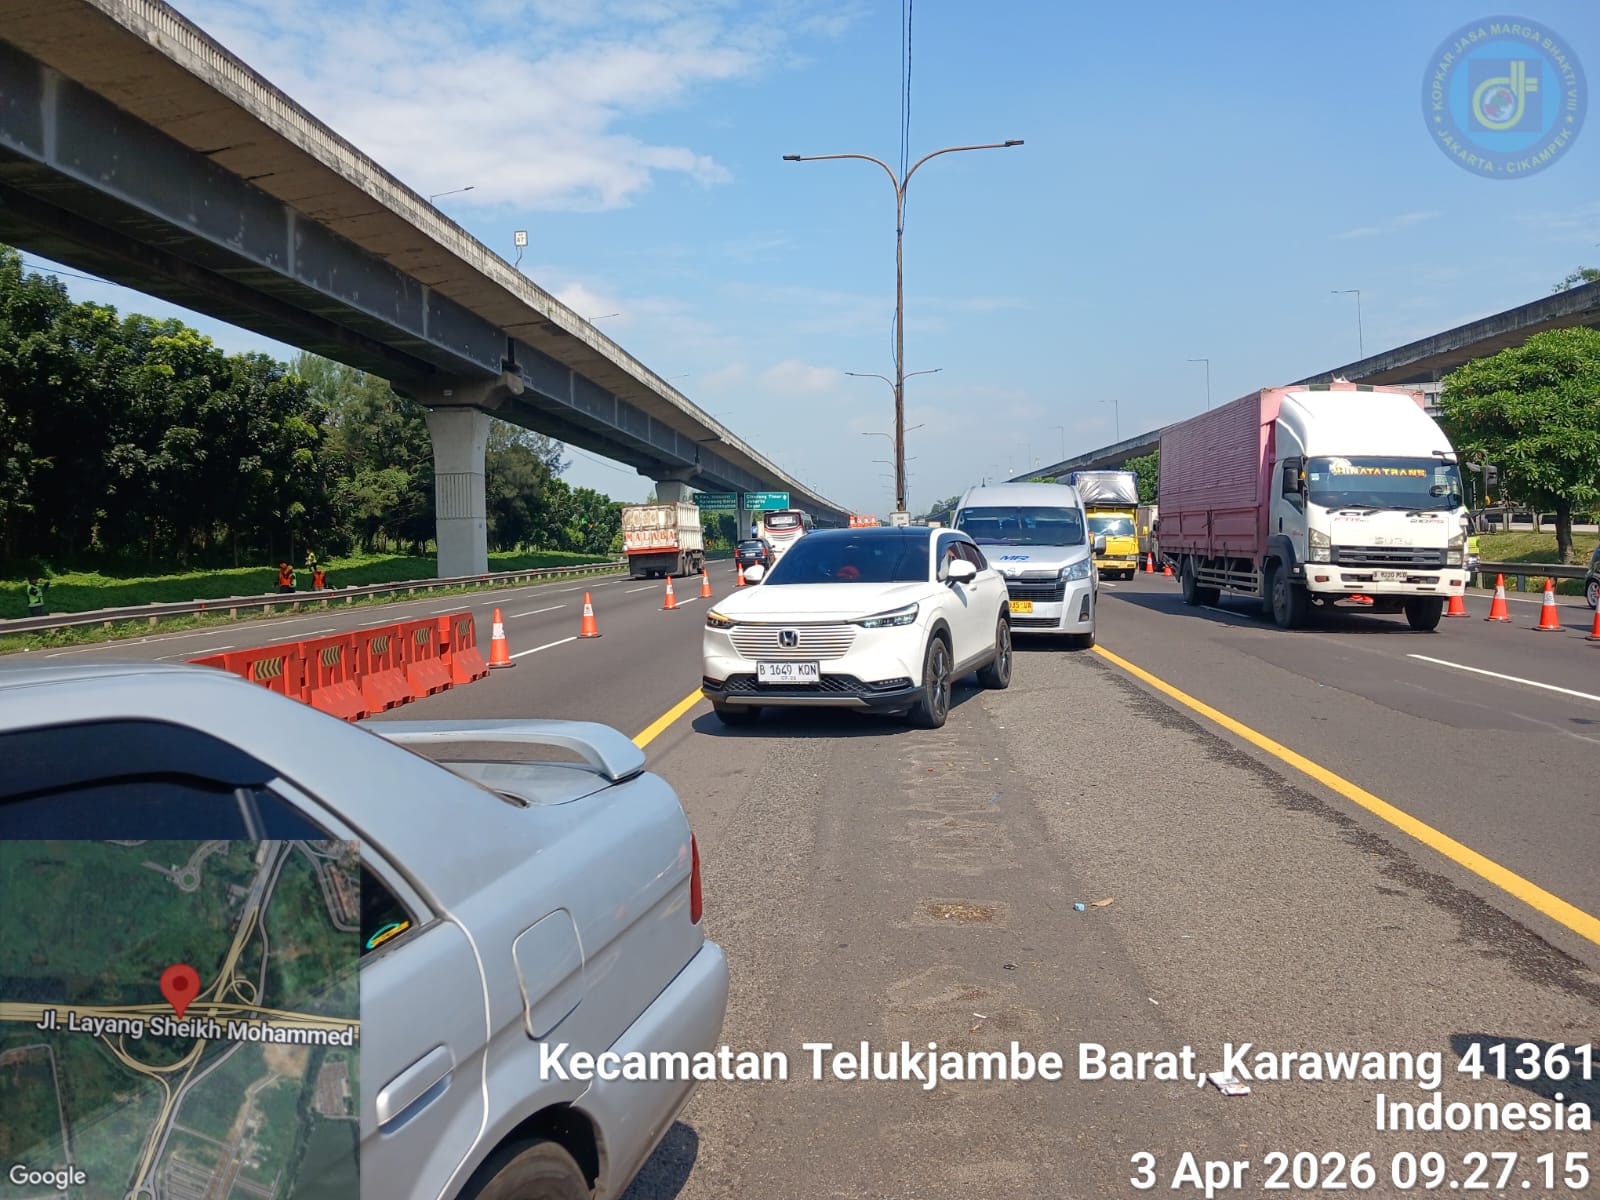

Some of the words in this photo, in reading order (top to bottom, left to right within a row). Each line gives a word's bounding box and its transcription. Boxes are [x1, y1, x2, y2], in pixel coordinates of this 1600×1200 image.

[1384, 467, 1427, 478] TRANS
[625, 529, 675, 541] MALABA
[760, 664, 766, 675] B
[770, 664, 792, 676] 1649
